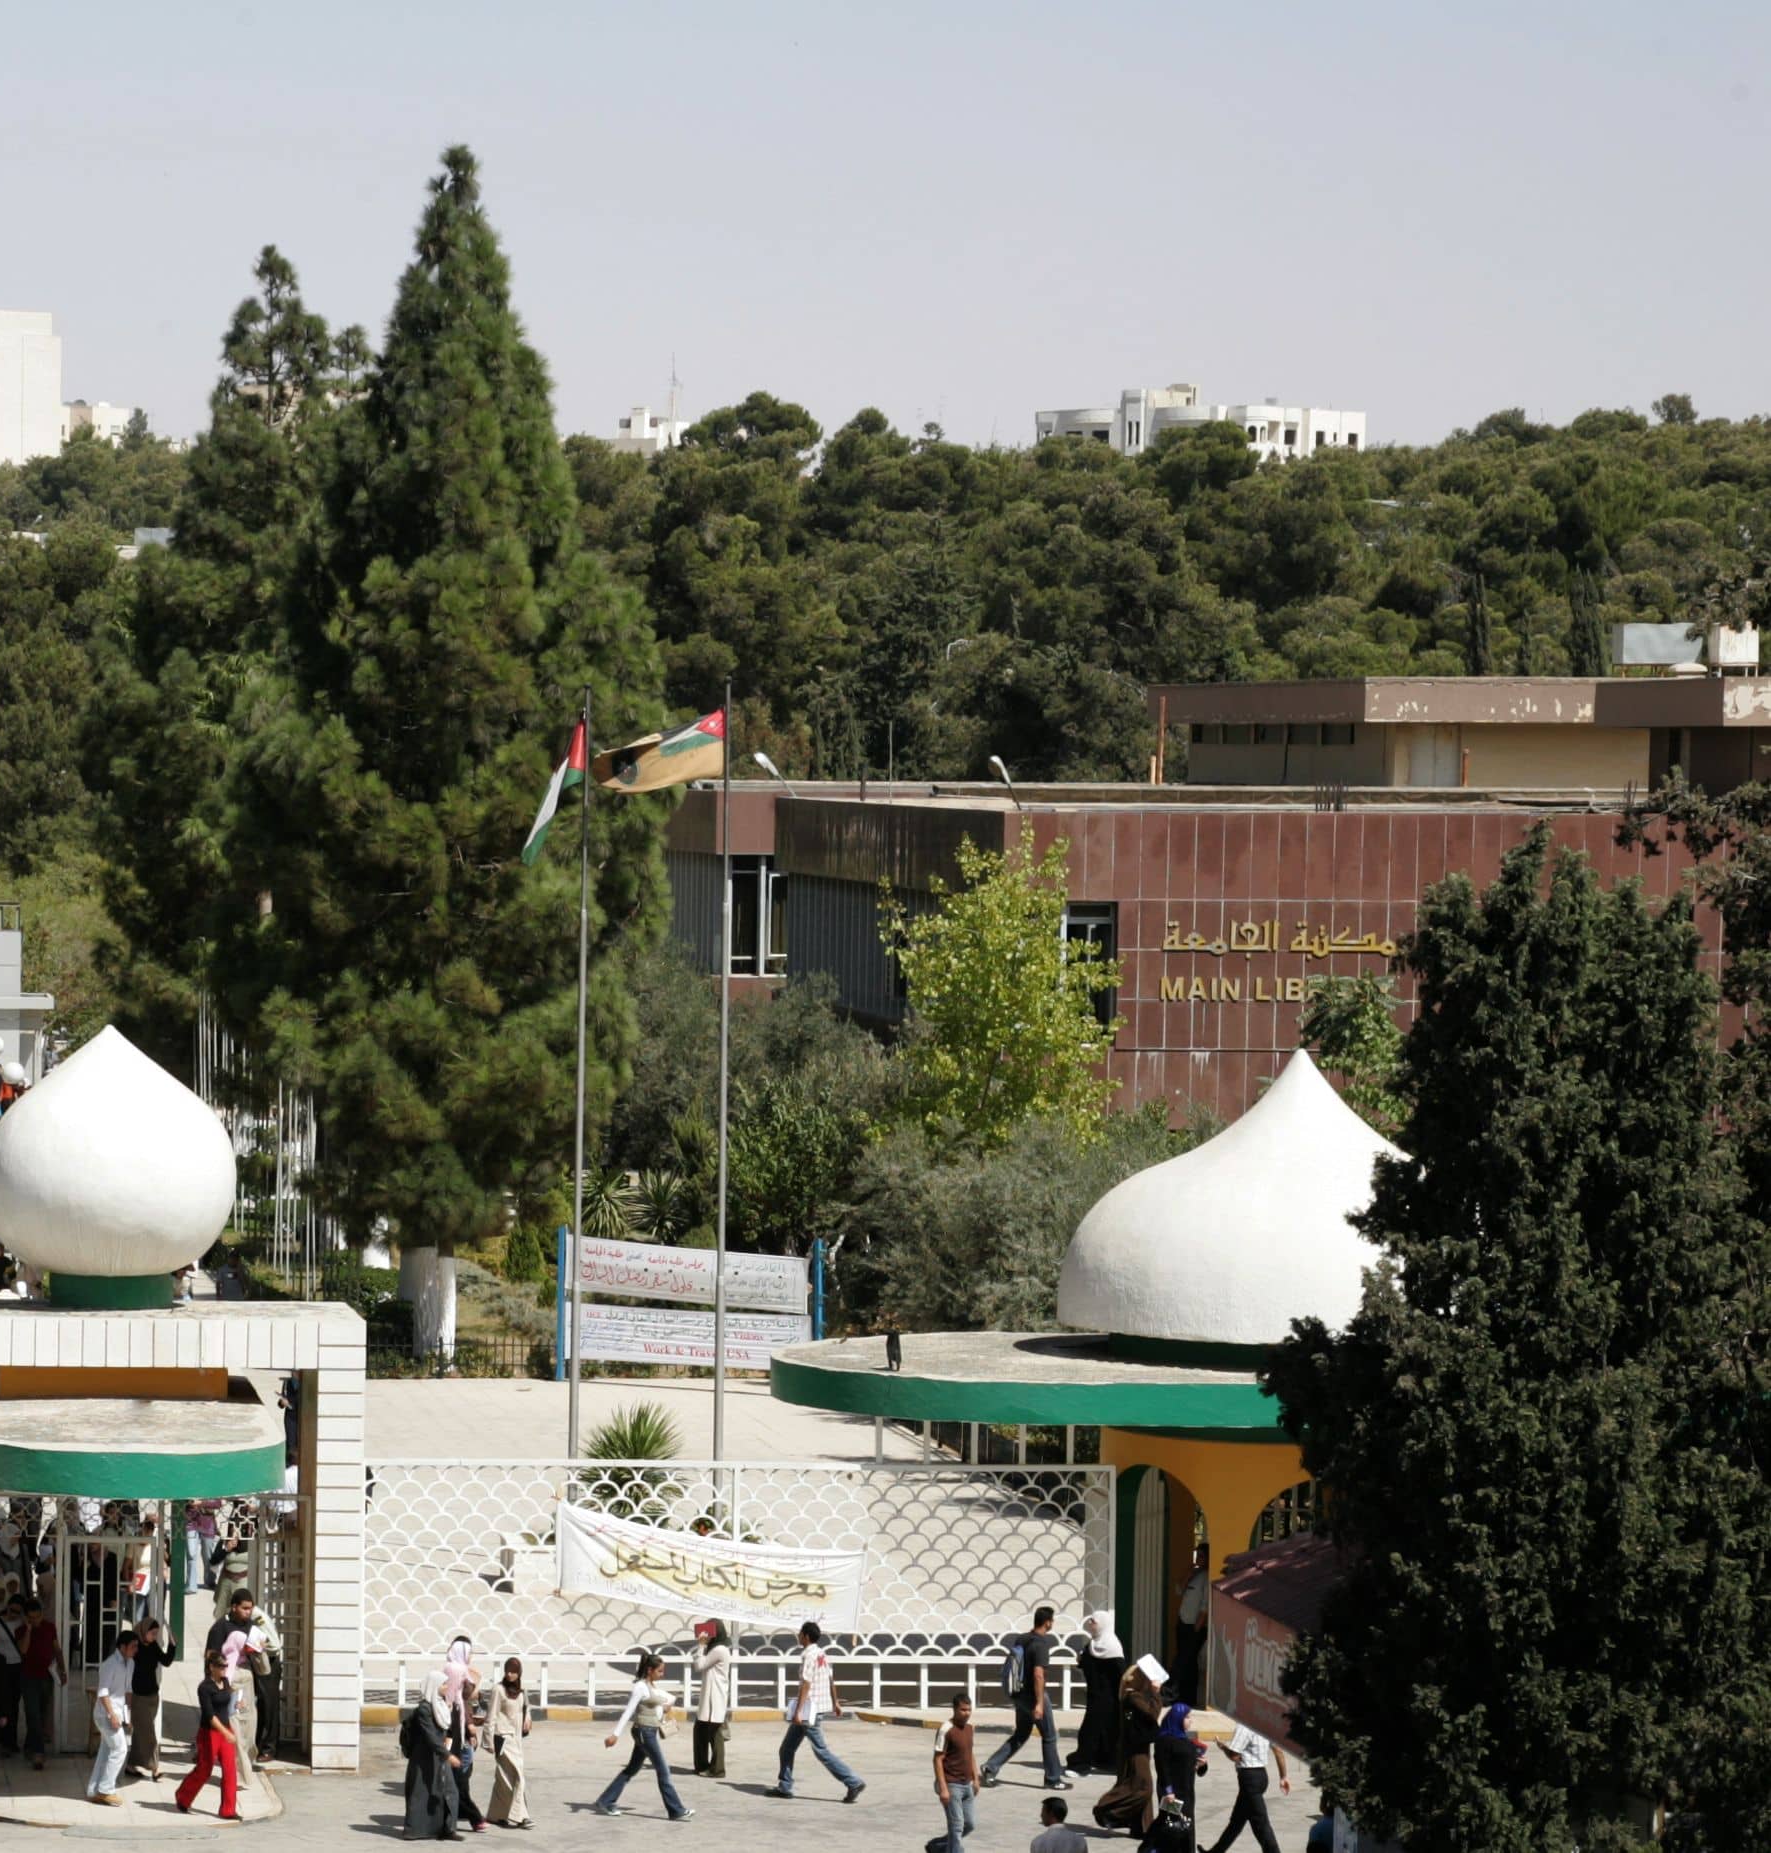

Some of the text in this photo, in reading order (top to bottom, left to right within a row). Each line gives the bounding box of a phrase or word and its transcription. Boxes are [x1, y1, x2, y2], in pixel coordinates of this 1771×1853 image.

[1162, 919, 1397, 961] مكتبة الجامعة
[1160, 976, 1241, 1002] MAIN
[643, 1343, 671, 1355] Work
[688, 1345, 718, 1359] Trave
[726, 1347, 751, 1360] USA
[672, 1559, 746, 1592] الكتاب
[747, 1573, 827, 1607] معرض
